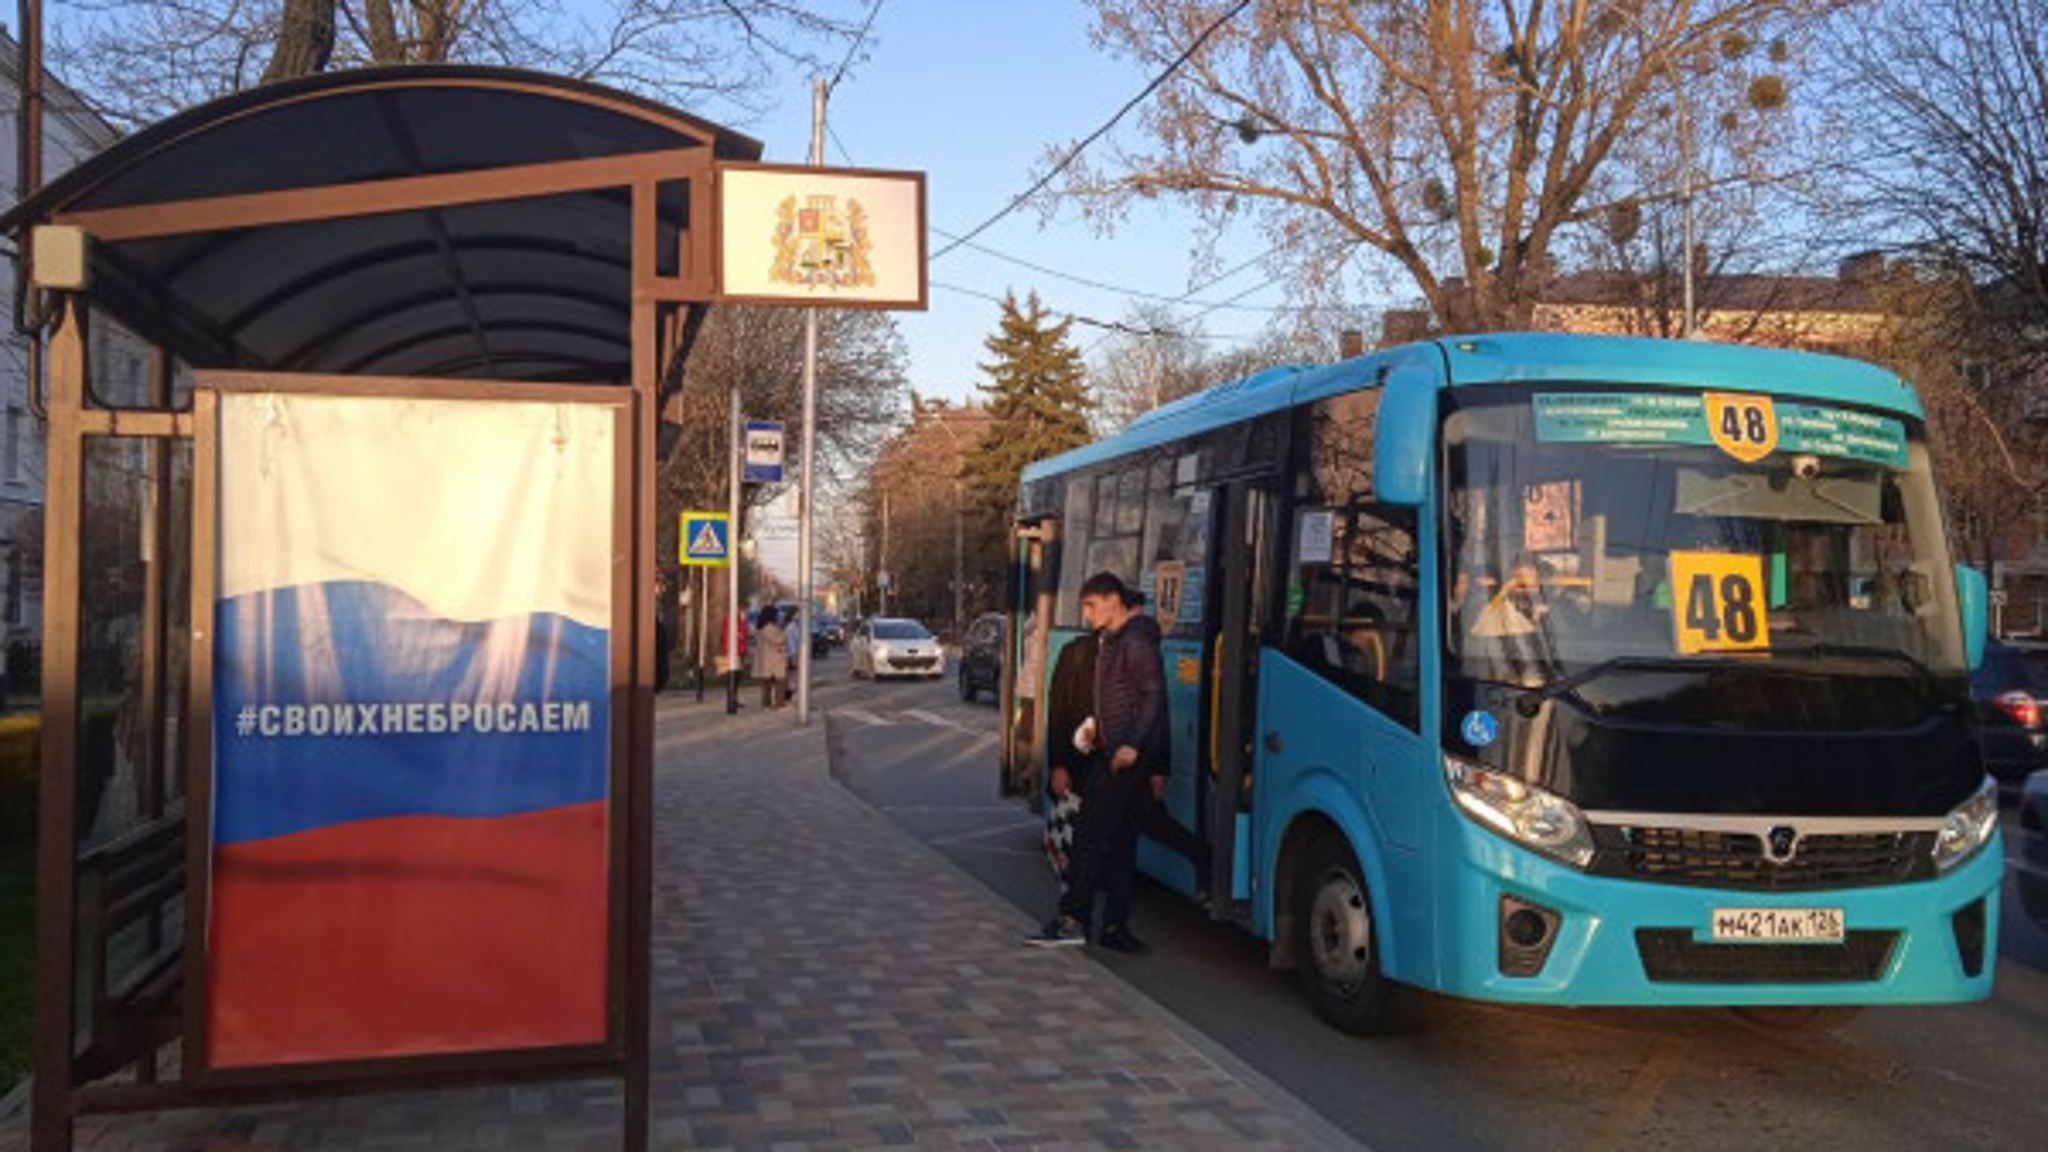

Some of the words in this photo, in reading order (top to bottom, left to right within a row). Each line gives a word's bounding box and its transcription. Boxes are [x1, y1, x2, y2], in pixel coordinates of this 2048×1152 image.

[1722, 405, 1766, 444] 48
[1686, 574, 1758, 642] 48
[236, 701, 591, 737] #СВОИХНЕБРОСАЕМ
